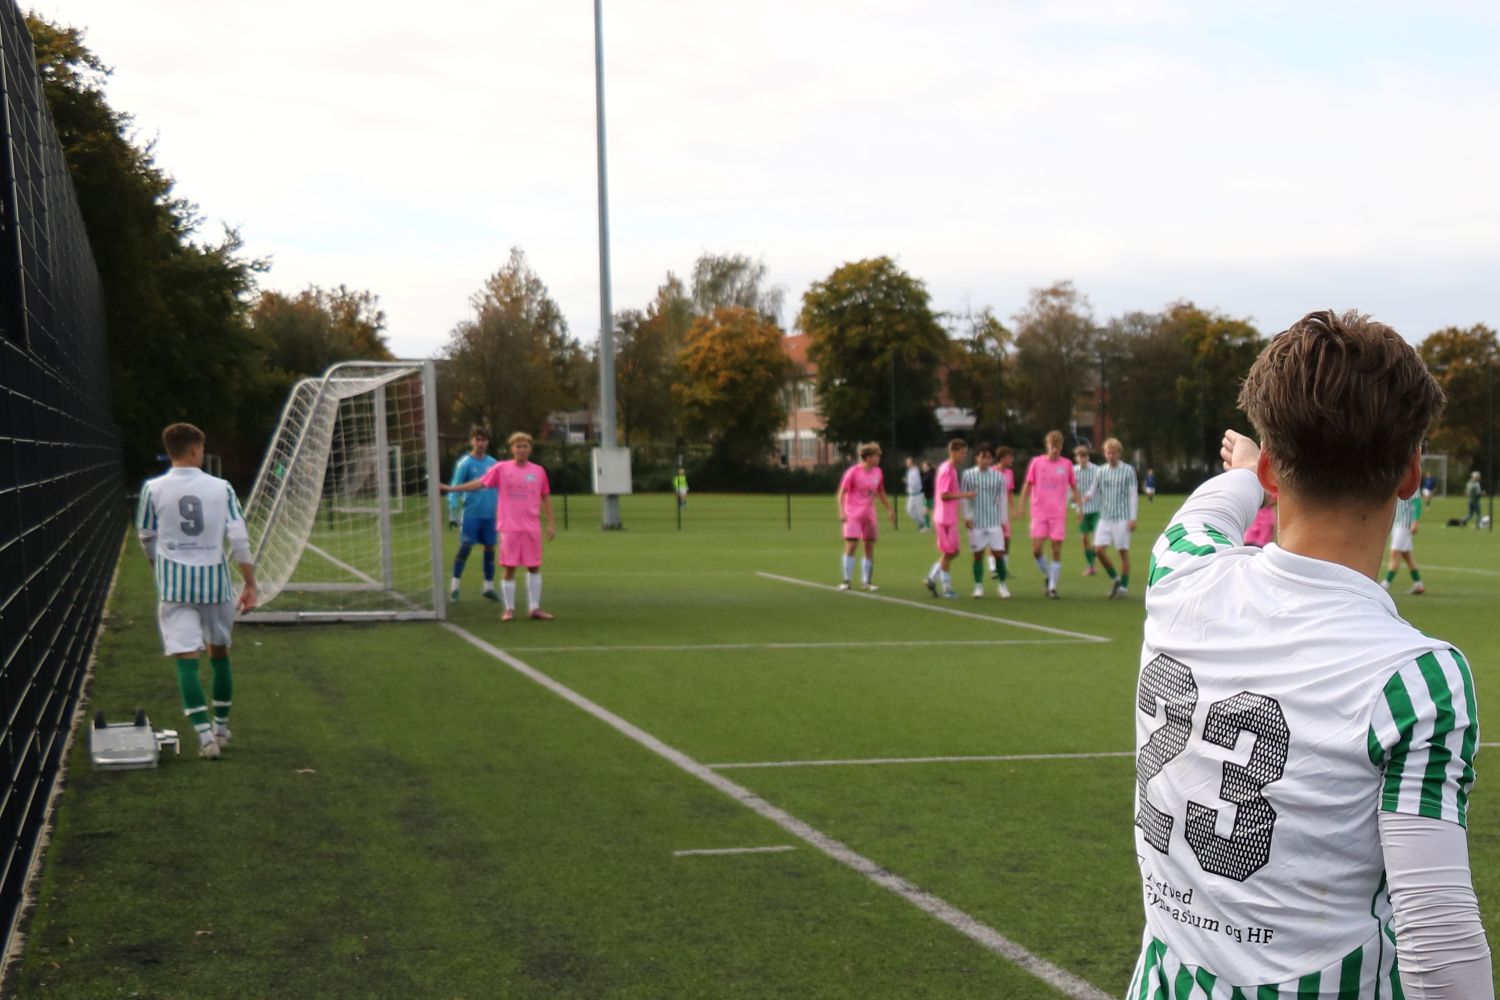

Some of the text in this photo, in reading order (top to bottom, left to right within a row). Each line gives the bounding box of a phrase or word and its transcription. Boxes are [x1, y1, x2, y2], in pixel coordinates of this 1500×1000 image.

[179, 495, 204, 536] 9
[1136, 652, 1290, 882] 23
[1225, 925, 1243, 942] og
[1247, 927, 1274, 944] HF
